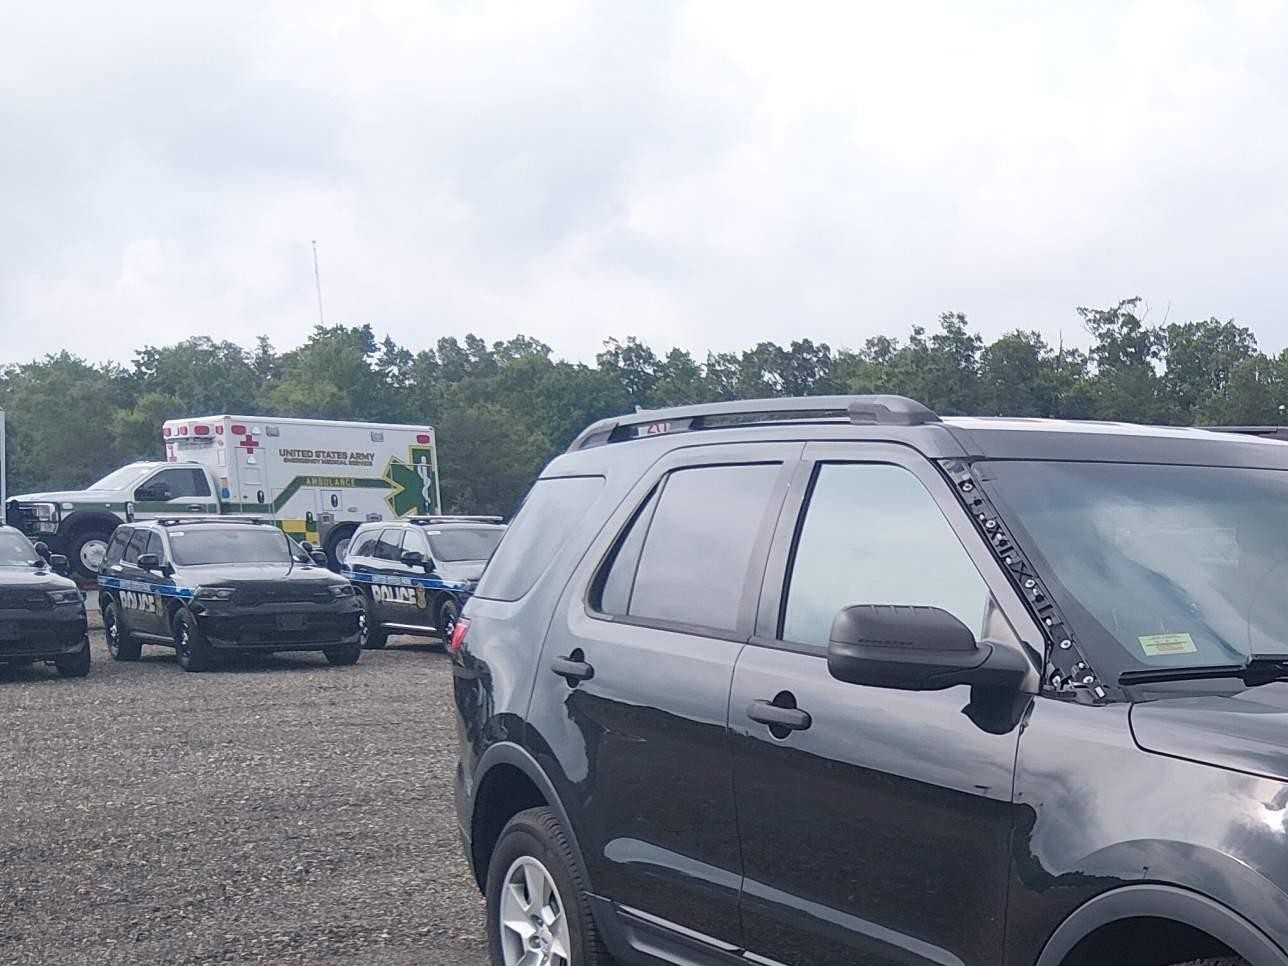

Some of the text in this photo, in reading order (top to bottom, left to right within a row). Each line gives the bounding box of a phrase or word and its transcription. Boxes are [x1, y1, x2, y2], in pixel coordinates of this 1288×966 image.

[279, 449, 375, 461] UNITED STATES ARMY
[305, 476, 355, 487] AMBULANCE
[119, 591, 155, 612] POLICE
[371, 584, 417, 605] POLICE
